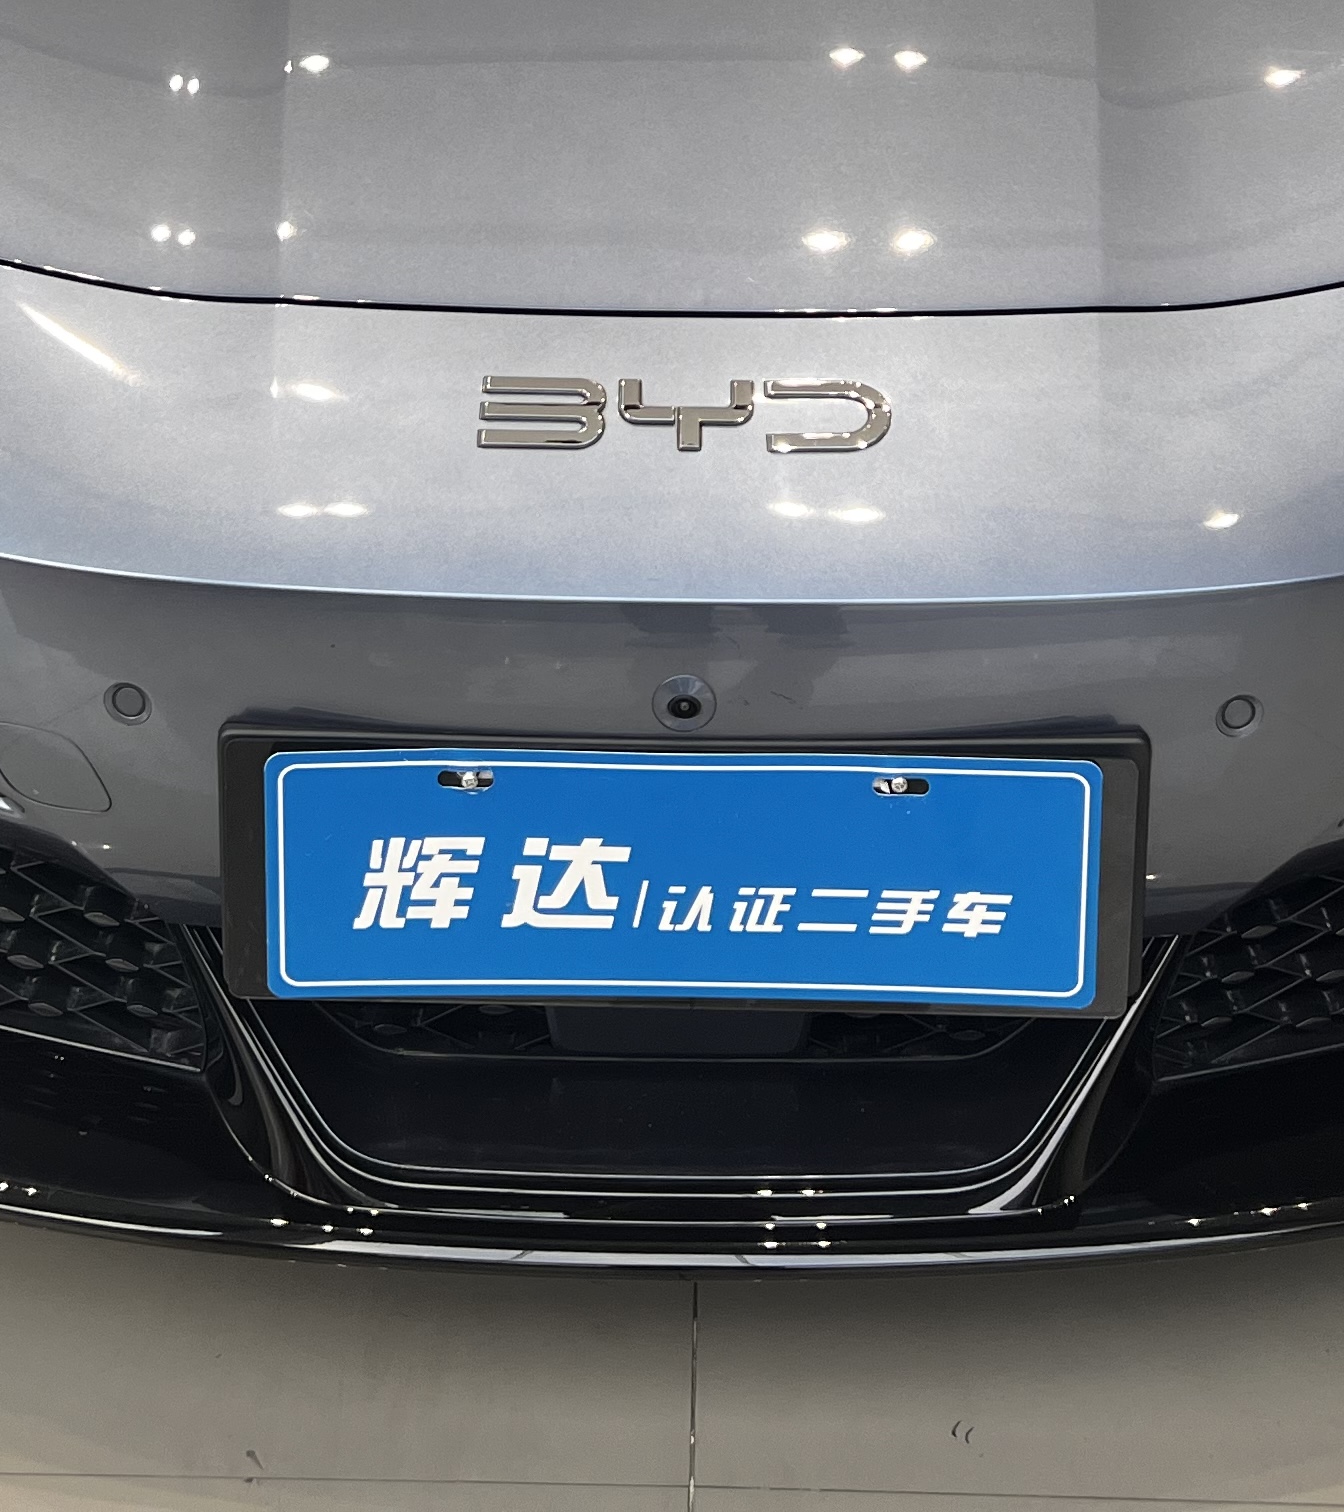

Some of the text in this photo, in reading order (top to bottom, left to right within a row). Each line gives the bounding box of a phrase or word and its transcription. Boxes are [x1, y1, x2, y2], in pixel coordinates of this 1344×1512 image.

[477, 375, 892, 452] BYD
[352, 836, 1015, 938] 辉达 认证二手车
